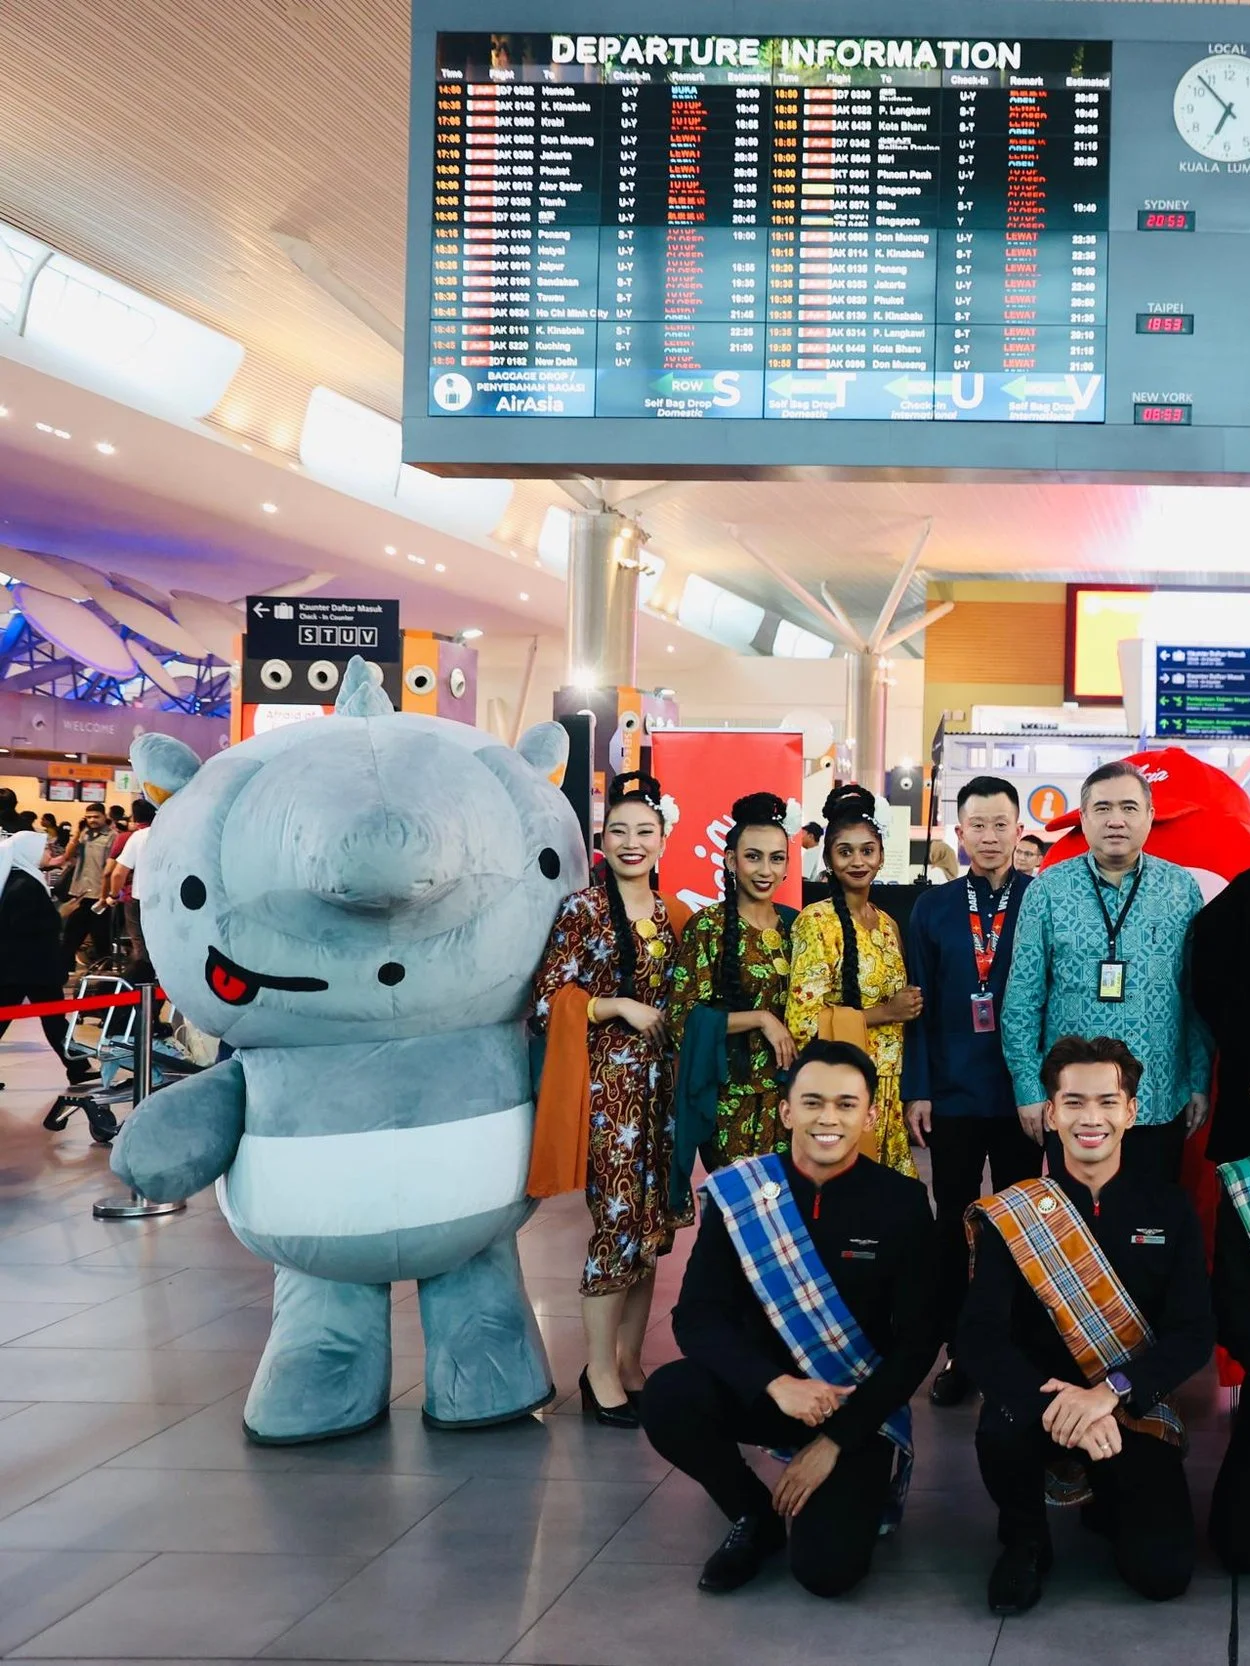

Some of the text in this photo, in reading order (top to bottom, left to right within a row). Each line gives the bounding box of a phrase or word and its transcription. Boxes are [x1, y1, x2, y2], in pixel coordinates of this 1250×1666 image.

[552, 36, 1020, 70] DEPARTURE INFORMATION
[1208, 44, 1247, 54] LOCAL
[441, 68, 462, 78] Time
[489, 69, 514, 80] Flight
[544, 70, 555, 80] To
[672, 72, 705, 82] Remark
[728, 73, 770, 82] Estimated
[1224, 70, 1235, 81] 12
[778, 74, 798, 83] Time
[880, 74, 892, 84] To
[1010, 76, 1044, 86] Remark
[1066, 77, 1110, 87] Estimated
[1193, 87, 1205, 98] 10
[890, 106, 930, 117] Langkawi
[1187, 104, 1194, 114] 9
[878, 121, 926, 131] Kota Bharu
[1192, 122, 1200, 132] 8
[541, 135, 559, 145] Don
[1242, 136, 1250, 147] 5
[1223, 141, 1231, 152] 6
[1179, 162, 1220, 172] KUALA
[878, 170, 932, 180] Phnom Penh
[877, 186, 922, 196] Singapore
[876, 200, 896, 210] Sibu
[1144, 200, 1189, 210] SYDNEY
[1006, 232, 1038, 240] LEWAT
[1148, 303, 1184, 314] TAIPEI
[536, 341, 571, 352] Kuching
[535, 357, 578, 366] New Delhi
[1004, 359, 1036, 368] LEWAT
[488, 372, 568, 381] BAGGAGE DROP
[476, 383, 545, 392] PENYERAHAN
[672, 371, 742, 408] ROW S
[826, 372, 857, 408] T
[952, 372, 984, 409] U
[1064, 374, 1102, 411] V
[1132, 392, 1194, 402] NEW YORK
[496, 396, 564, 412] AirAsia
[644, 399, 712, 410] Self Bag Drop
[769, 400, 789, 410] Self
[790, 401, 810, 412] Bag
[656, 408, 704, 418] Domestic
[781, 410, 828, 419] Domestic
[891, 410, 958, 420] International
[299, 603, 383, 613] Kaunter Daftar Masuk
[304, 629, 374, 644] S T U V
[63, 720, 116, 735] WELCOME
